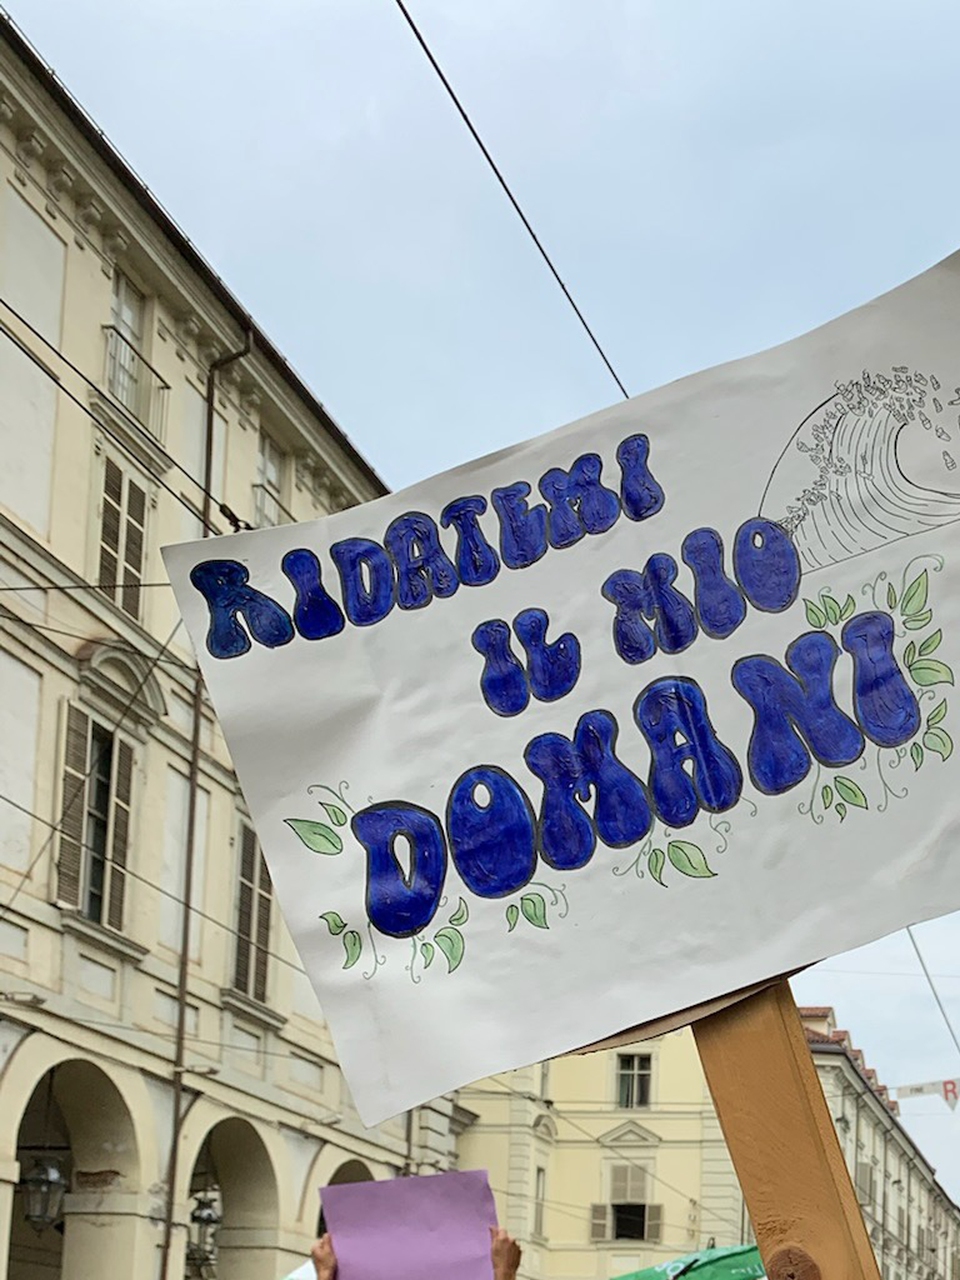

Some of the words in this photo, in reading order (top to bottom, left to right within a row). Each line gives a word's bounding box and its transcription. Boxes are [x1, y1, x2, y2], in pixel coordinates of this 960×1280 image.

[191, 434, 665, 659] RIDATEMI
[471, 608, 581, 716] IL
[602, 517, 801, 664] MIO
[351, 610, 922, 938] DOMANI
[943, 1080, 958, 1101] R
